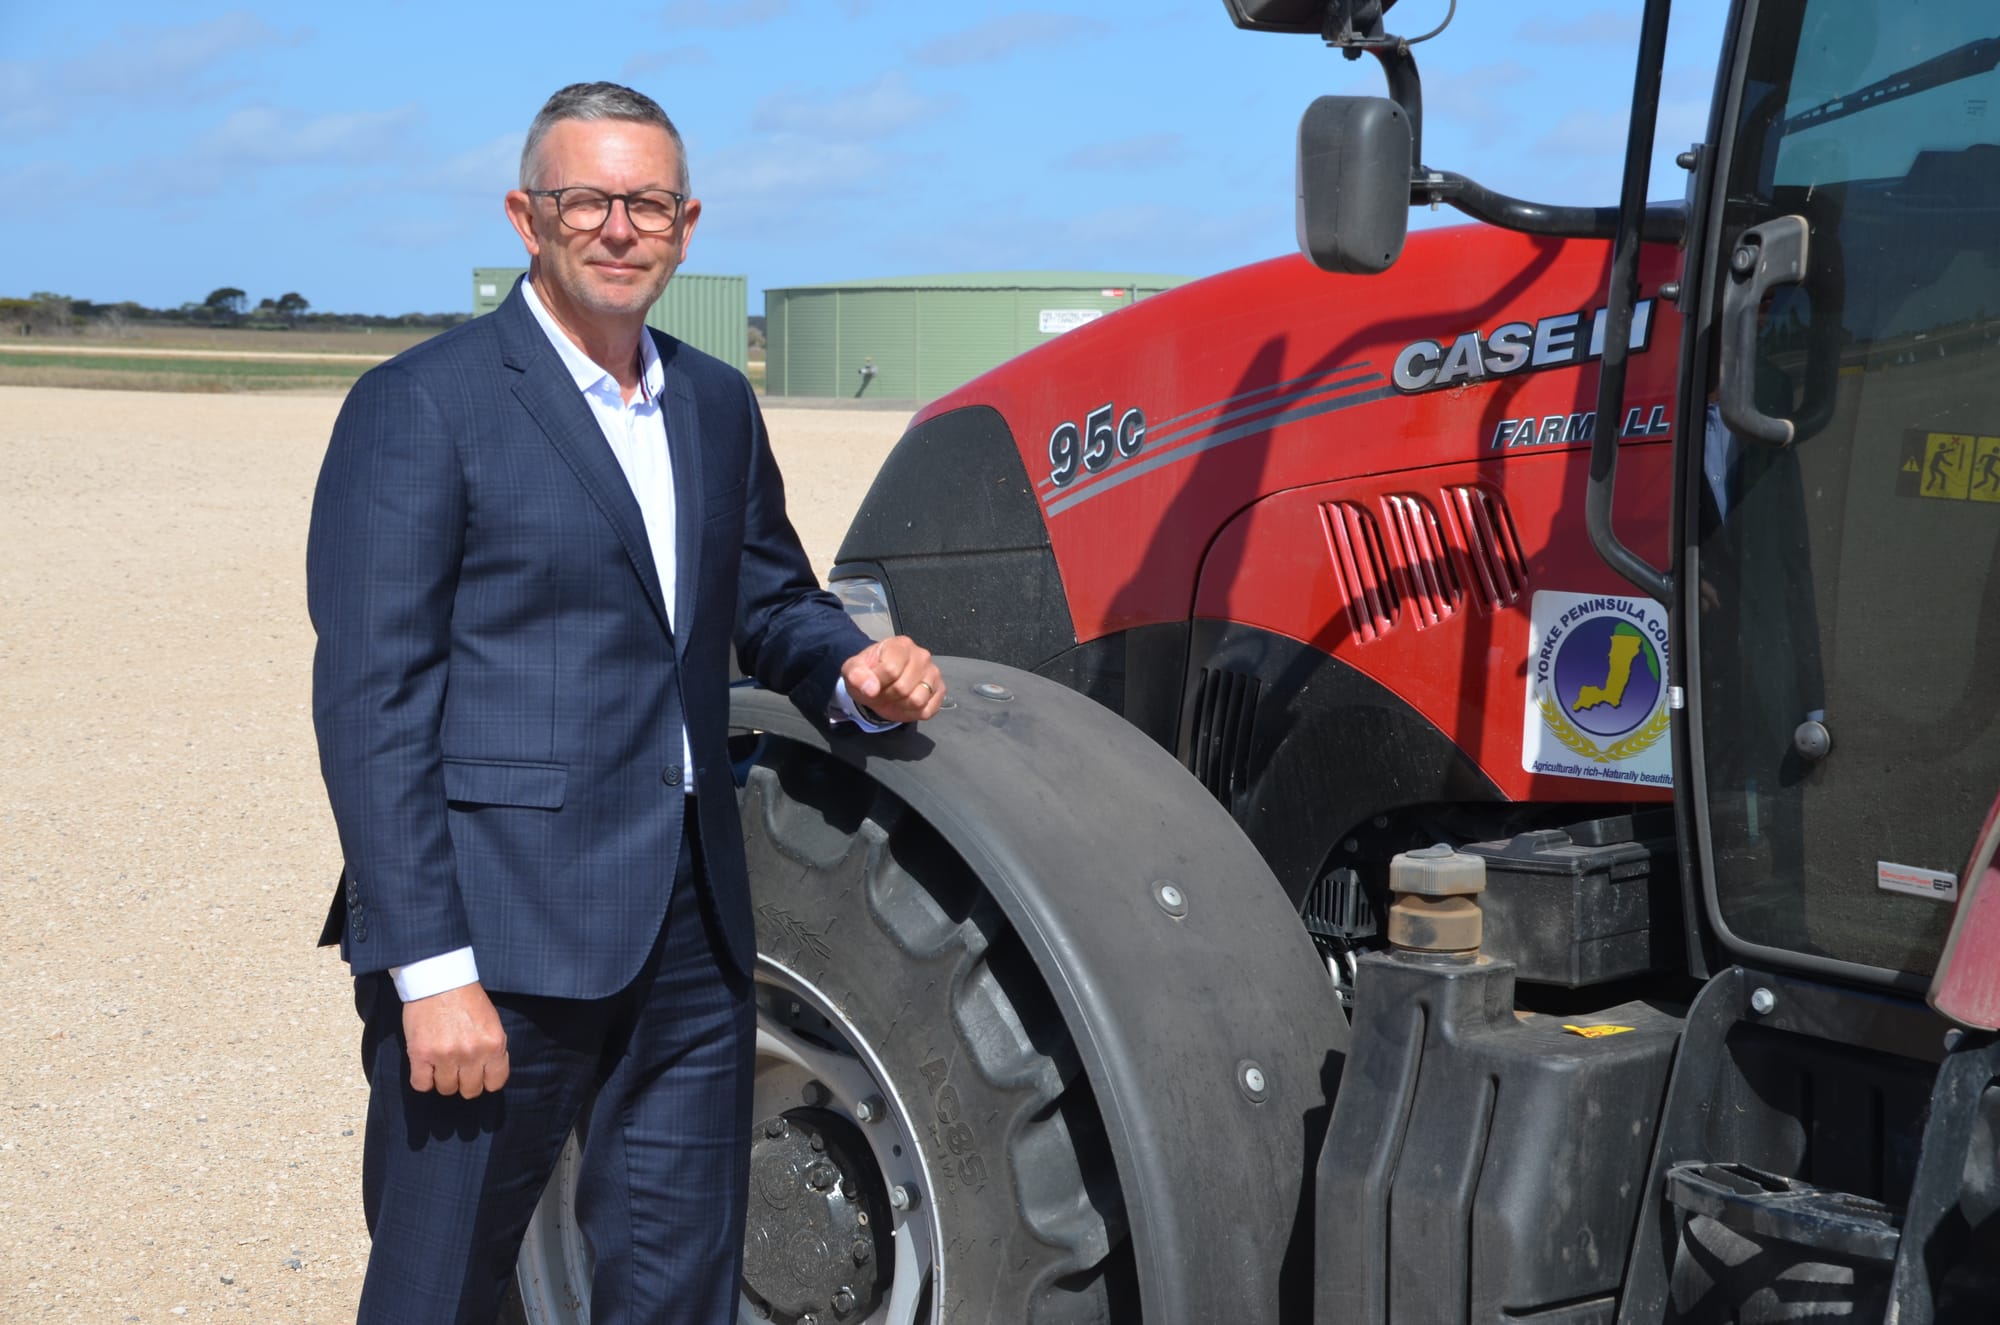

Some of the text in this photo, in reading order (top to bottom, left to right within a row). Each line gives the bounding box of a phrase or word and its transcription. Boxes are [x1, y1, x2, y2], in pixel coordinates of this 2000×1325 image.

[1392, 311, 1582, 393] CASE
[1491, 405, 1671, 449] FARMLL
[1537, 625, 1563, 684] YORKE
[1560, 598, 1647, 628] PENINSULA
[1532, 760, 1582, 776] Agriculturally
[1640, 771, 1673, 785] beautifu
